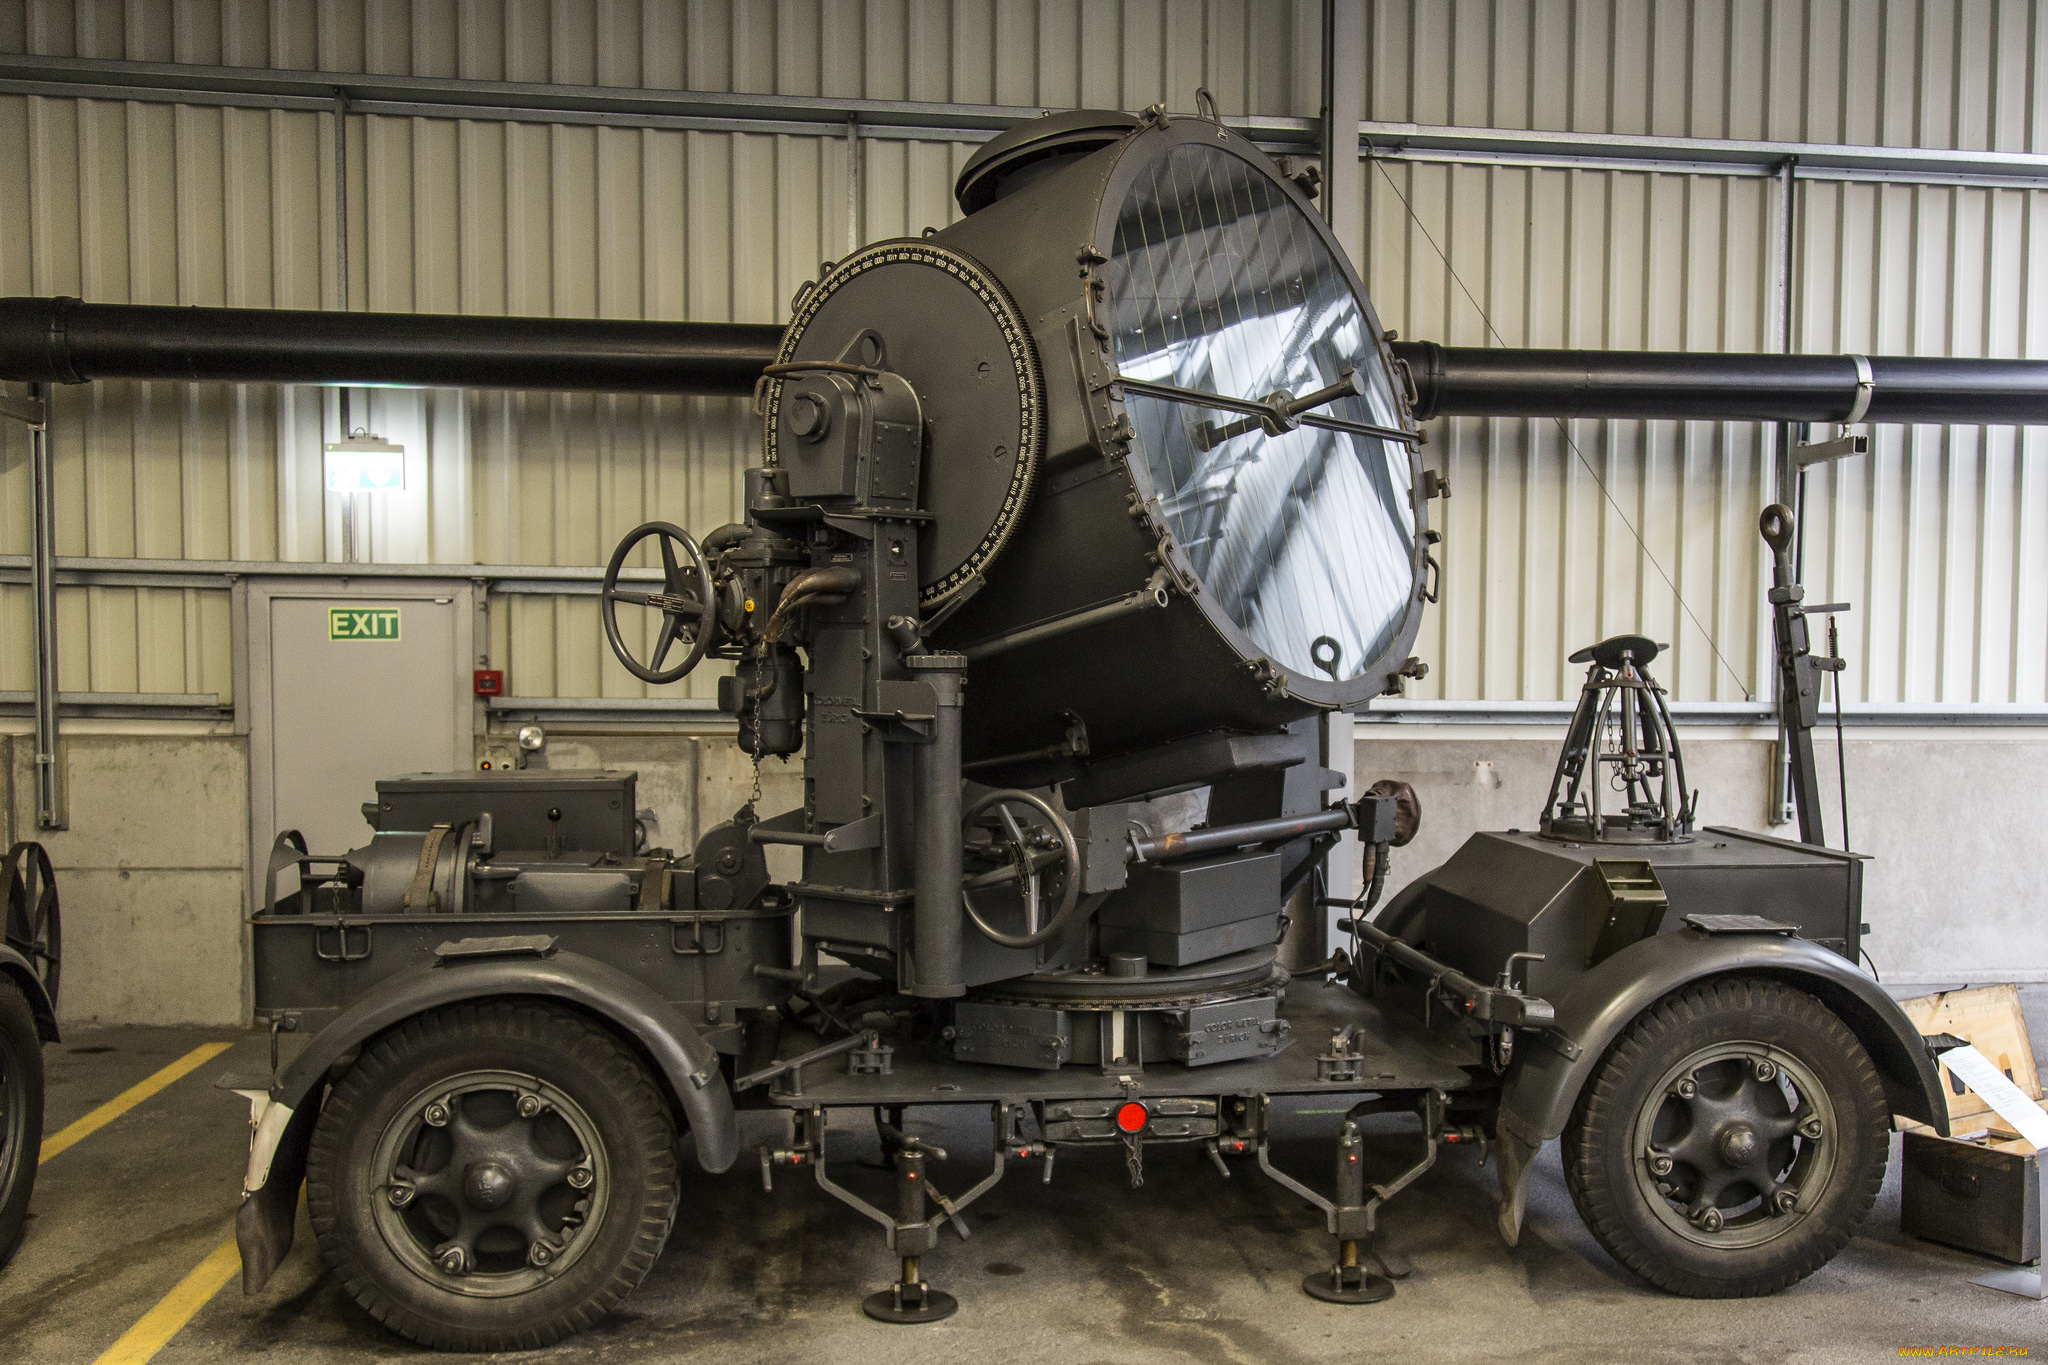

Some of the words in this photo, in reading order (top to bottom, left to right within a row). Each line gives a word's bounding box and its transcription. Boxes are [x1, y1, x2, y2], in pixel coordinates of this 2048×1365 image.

[887, 253, 897, 261] 4100
[839, 272, 850, 283] 3700
[997, 314, 1007, 328] 5100
[788, 339, 797, 353] 3100
[1010, 480, 1020, 496] 6100
[1004, 496, 1014, 511] 6200
[981, 540, 990, 551] 100
[971, 552, 980, 563] 200
[332, 613, 397, 636] EXIT
[1205, 1020, 1233, 1033] COLOR
